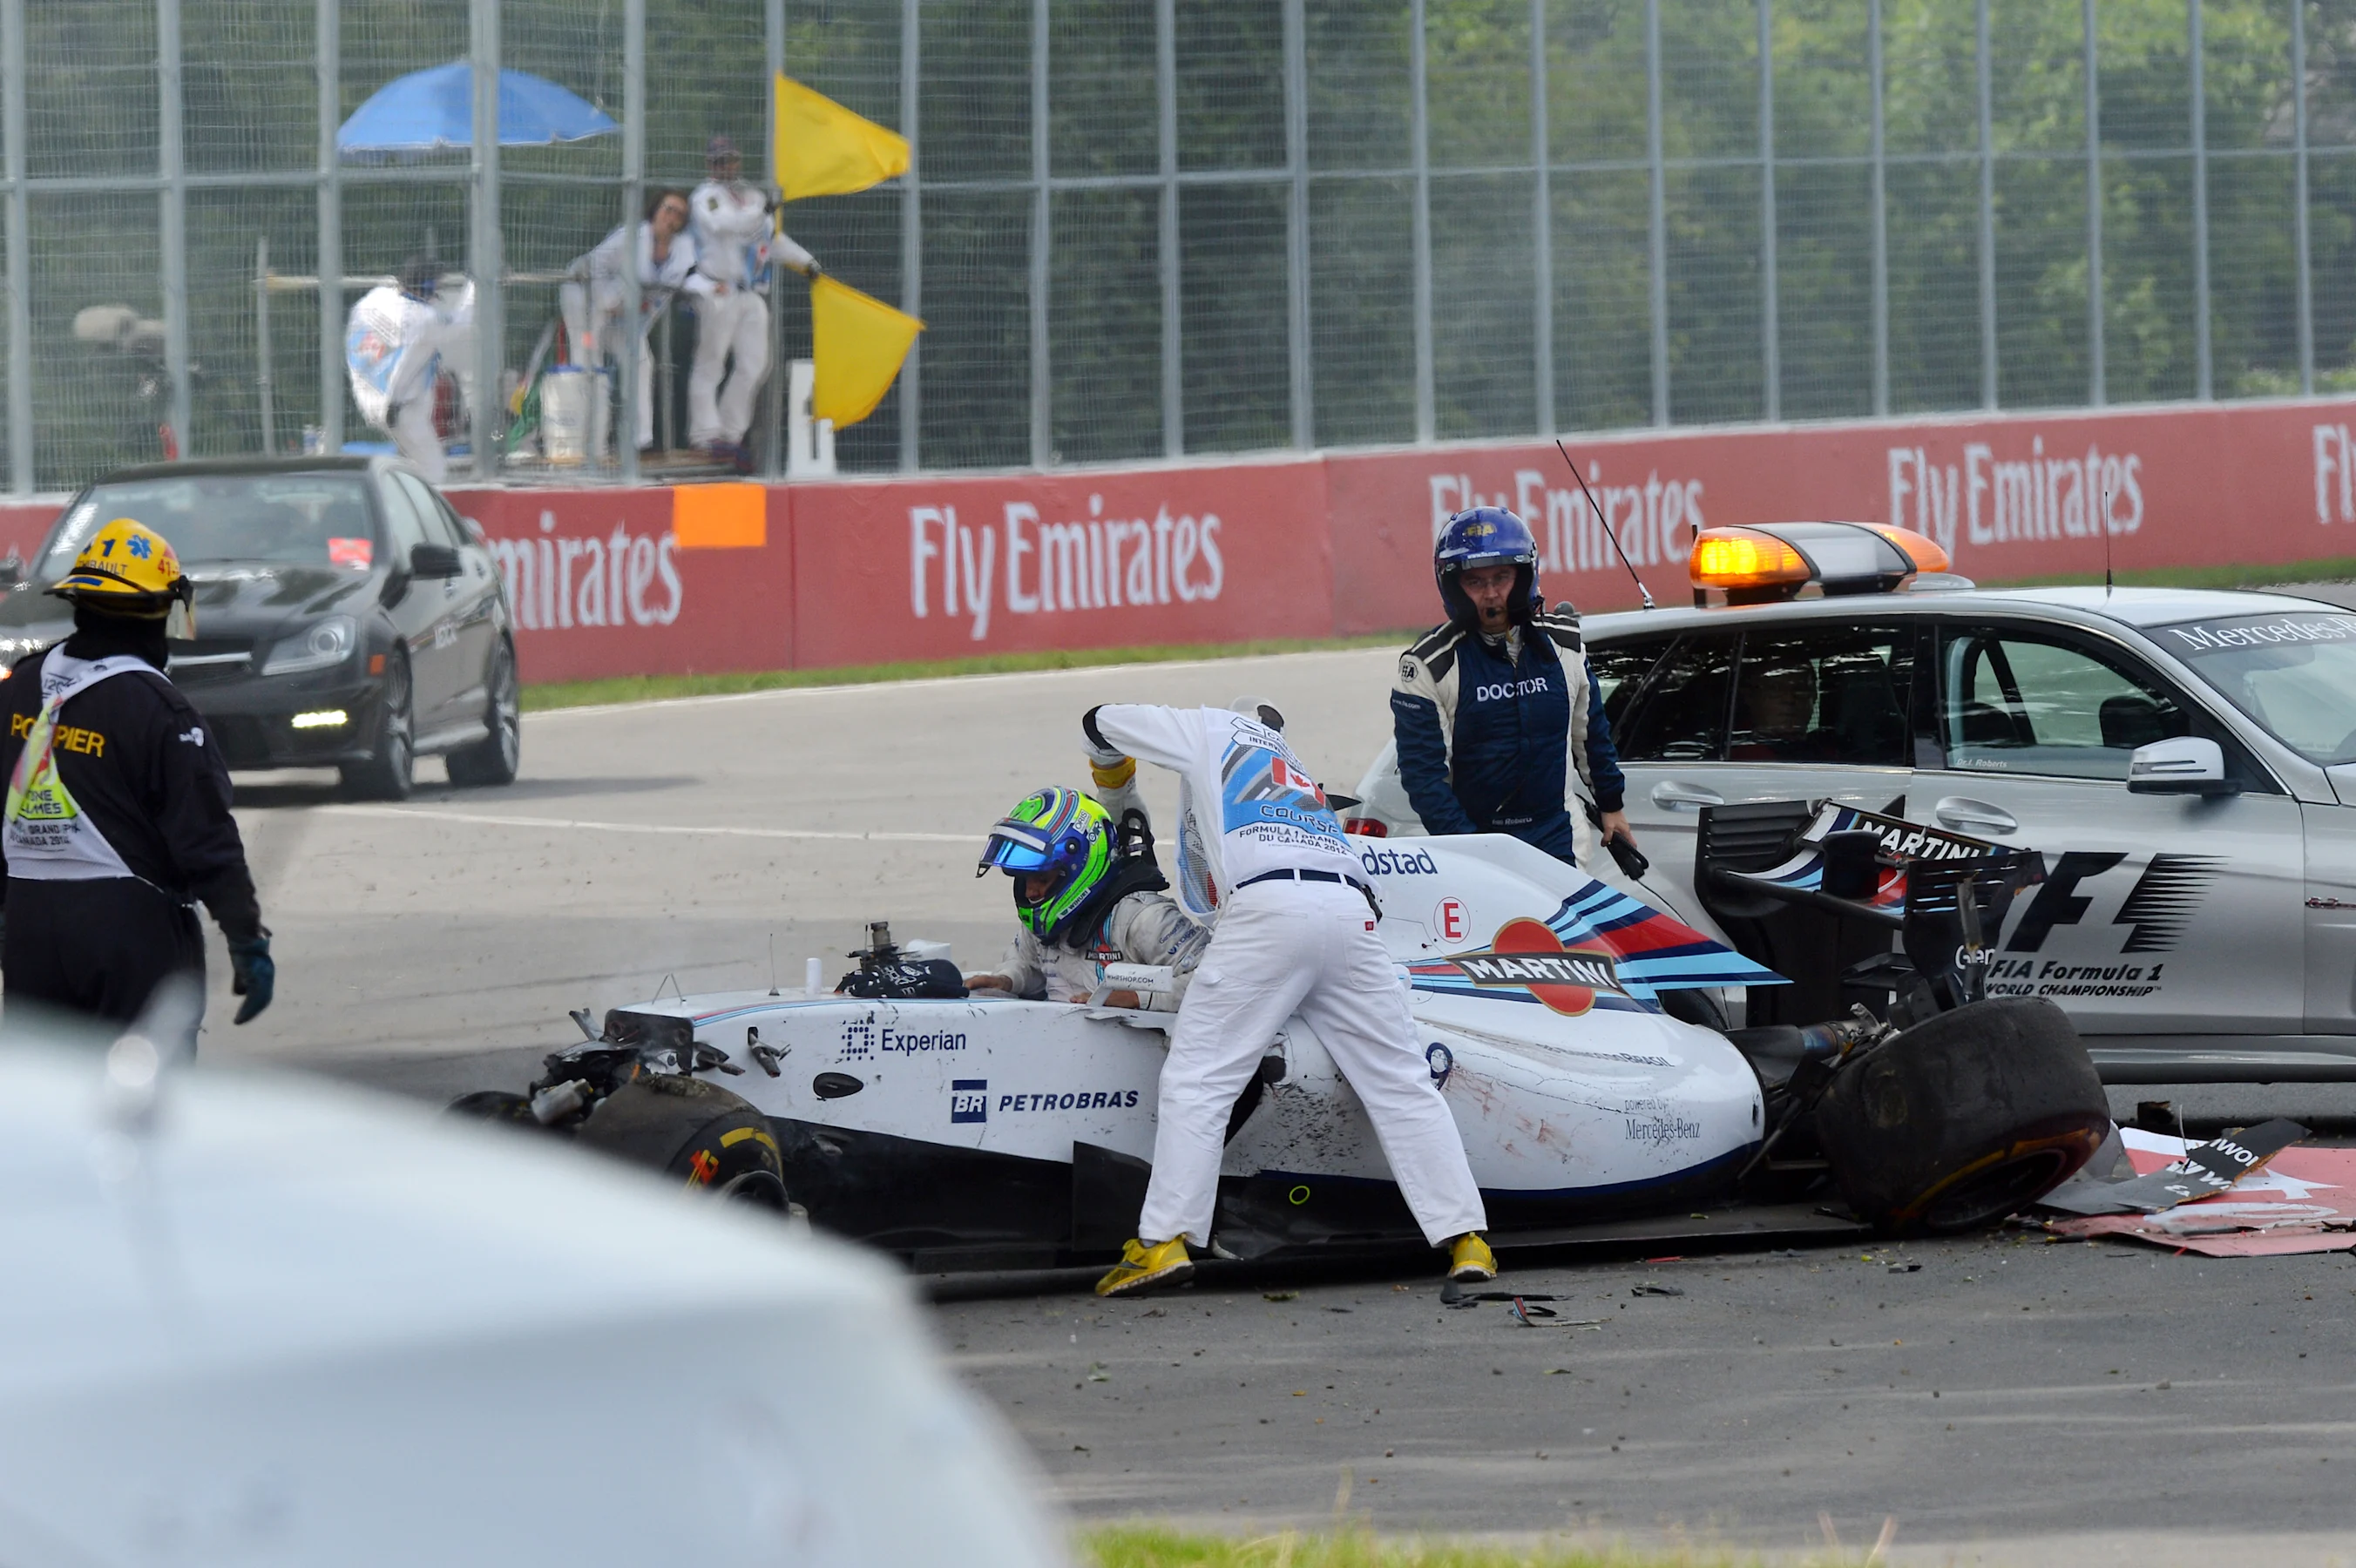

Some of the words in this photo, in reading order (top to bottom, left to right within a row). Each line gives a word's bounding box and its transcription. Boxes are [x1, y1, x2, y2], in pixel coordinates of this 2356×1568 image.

[2312, 422, 2356, 524] Fl
[1514, 458, 1708, 574] Emirates
[1888, 445, 1958, 571] Fly
[1964, 434, 2144, 545] Emirates
[158, 558, 179, 578] 41-
[464, 509, 684, 631] mirates
[910, 504, 995, 641] Fly
[1004, 493, 1225, 615] Emirates
[2168, 616, 2356, 652] Mercedes-B
[1476, 677, 1548, 702] DOCTOR
[10, 713, 105, 759] POPIER
[1975, 759, 2008, 767] Roberts
[1074, 811, 1087, 830] ORIS
[1239, 825, 1292, 839] FORMULA
[1261, 805, 1340, 836] COURSE
[1259, 834, 1275, 842] DU
[1859, 820, 1984, 862] MARTINI
[1443, 902, 1462, 938] E
[1460, 957, 1619, 990] MARTINI
[1989, 960, 2032, 980] FIA
[2038, 962, 2140, 982] Formula
[2146, 963, 2164, 982] 1
[1985, 983, 2034, 997] WORLD
[881, 1028, 966, 1056] Experian
[954, 1095, 985, 1114] BR
[999, 1090, 1139, 1112] PETROBRAS
[1624, 1098, 1656, 1113] powered
[1625, 1118, 1701, 1140] Mercedes-Benz
